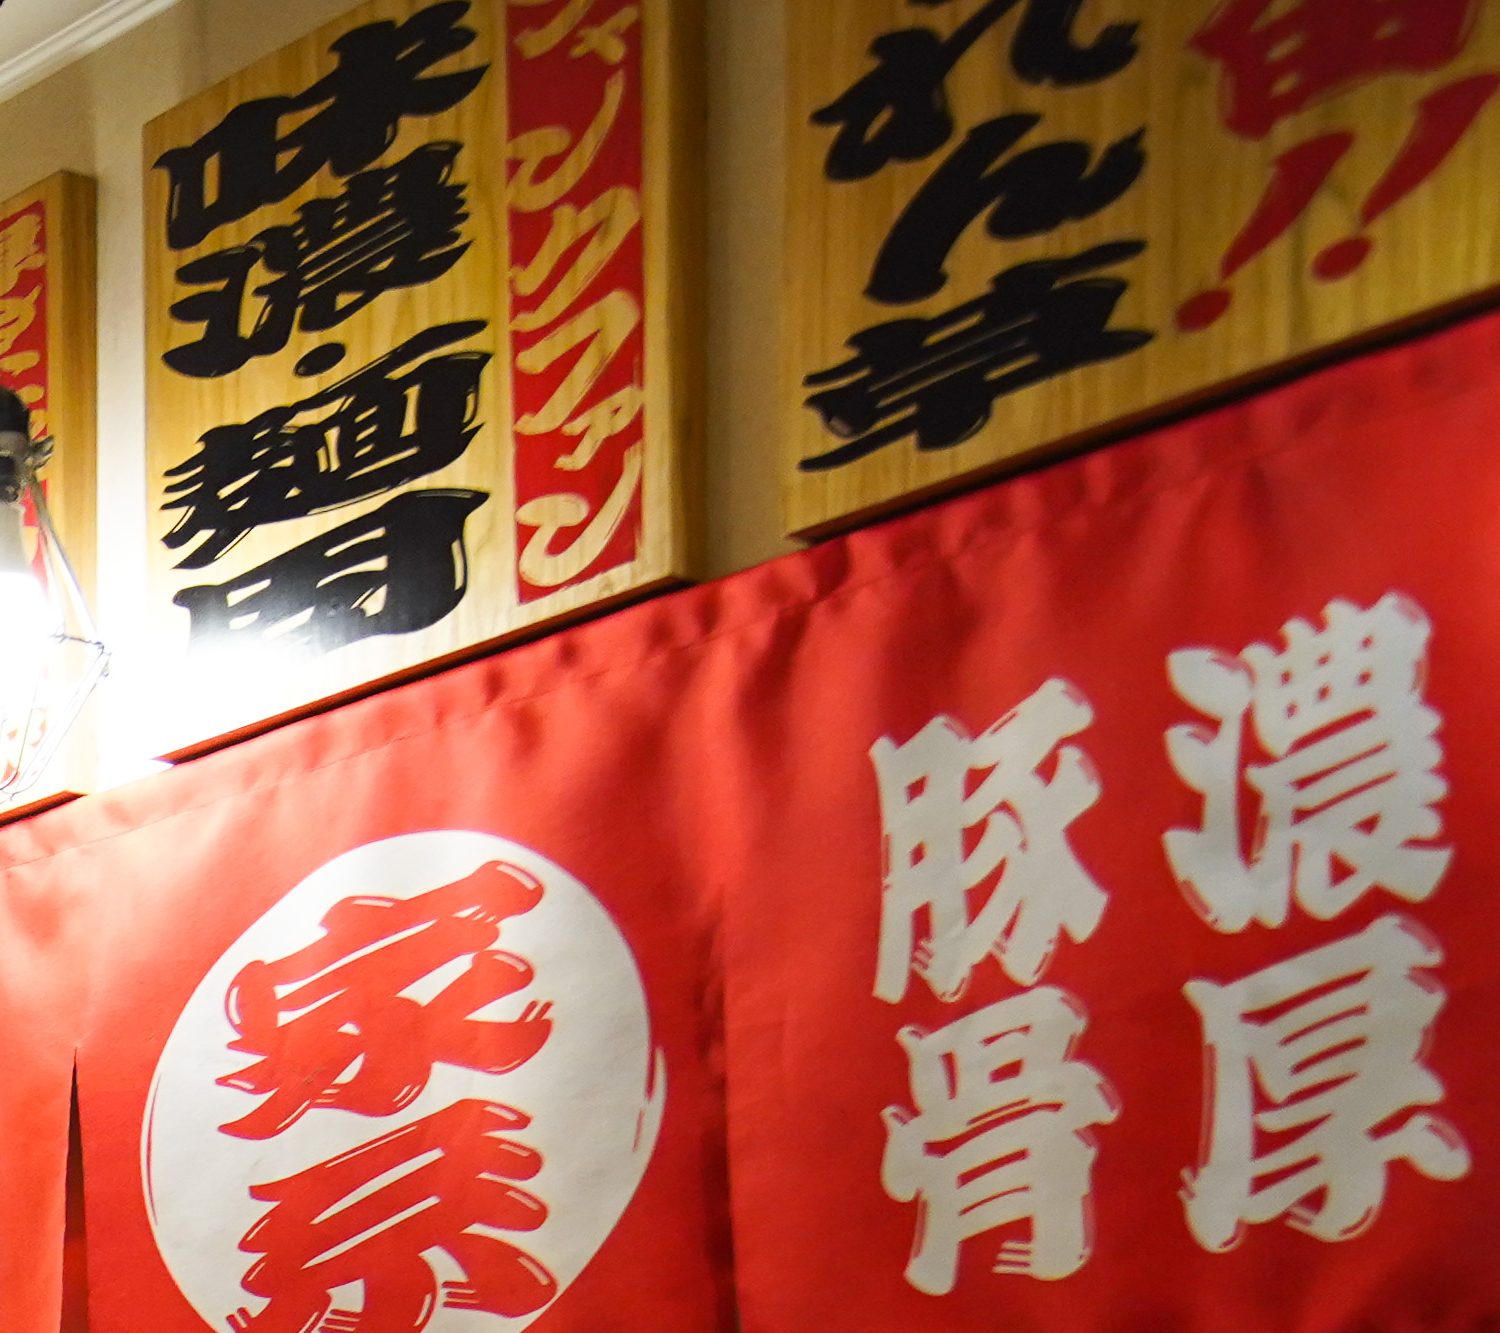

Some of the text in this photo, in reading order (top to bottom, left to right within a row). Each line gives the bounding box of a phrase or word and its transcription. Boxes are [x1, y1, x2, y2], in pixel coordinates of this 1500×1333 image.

[506, 0, 642, 588] ャンクファン
[867, 676, 1121, 1297] 豚骨
[1160, 591, 1471, 1252] 濃厚
